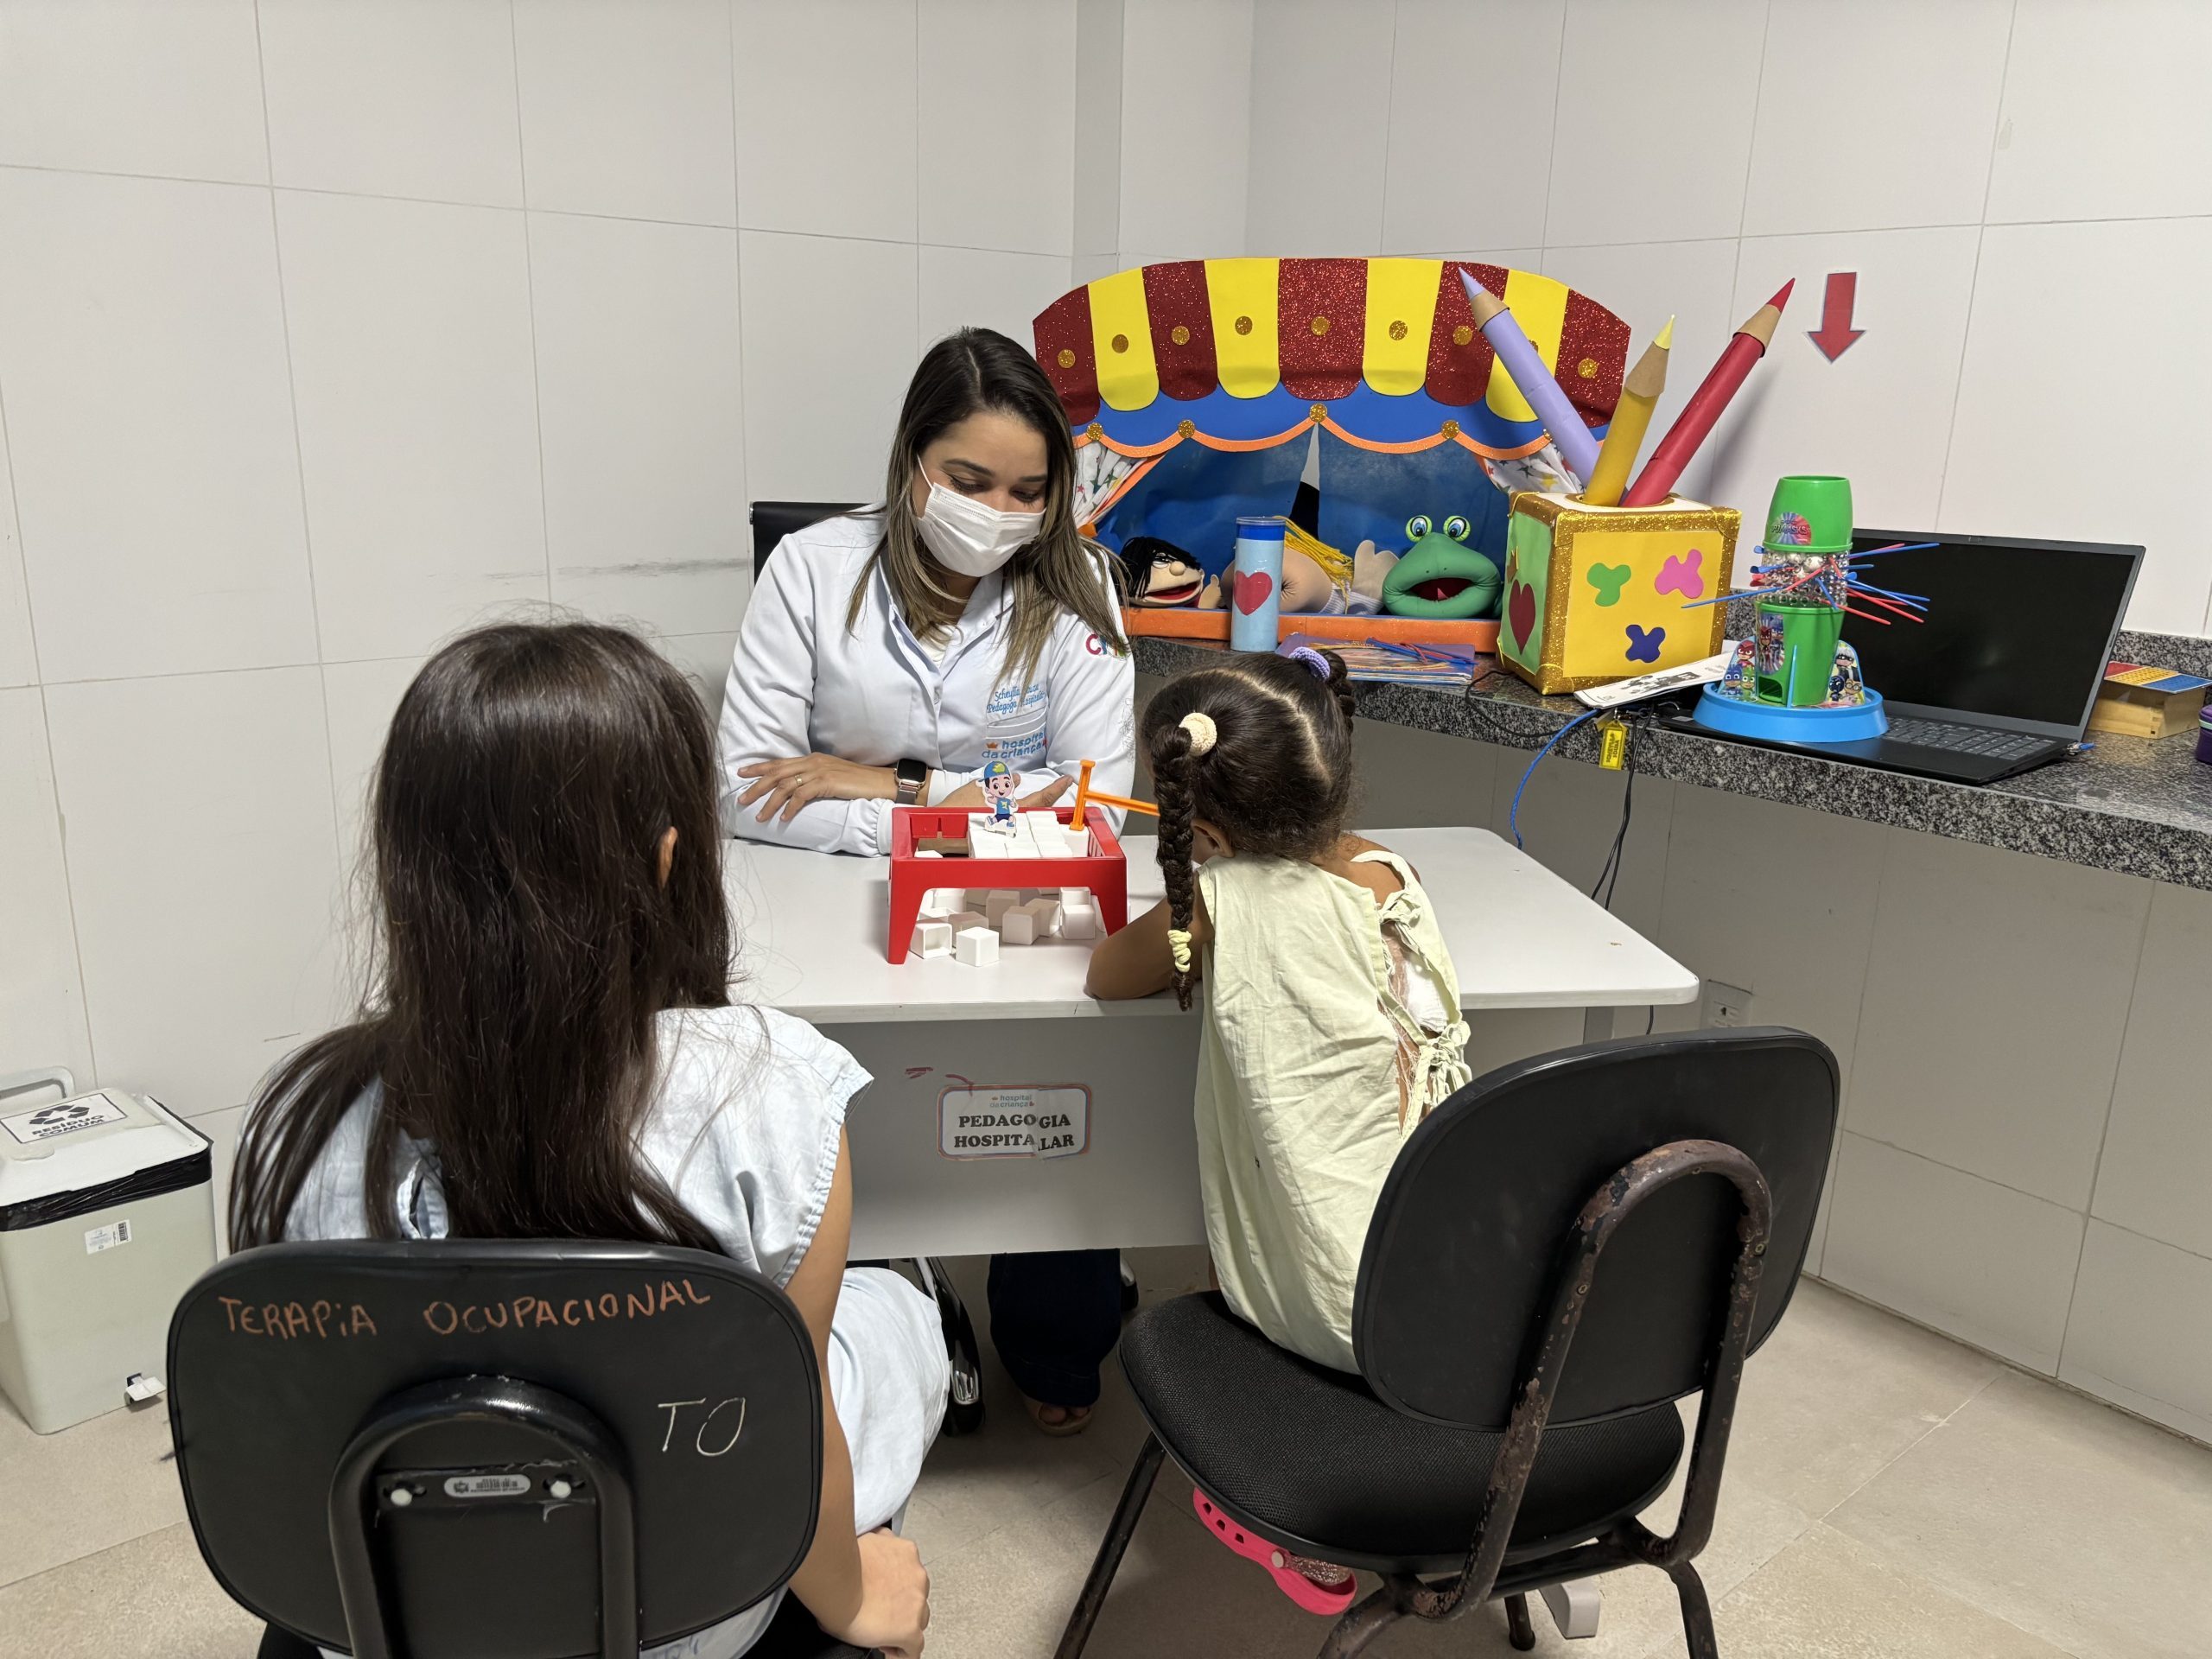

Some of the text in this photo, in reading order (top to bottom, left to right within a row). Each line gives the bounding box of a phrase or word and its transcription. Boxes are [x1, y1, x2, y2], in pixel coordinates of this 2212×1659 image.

[1002, 730, 1046, 749] hospital
[982, 750, 998, 759] da
[39, 1119, 105, 1136] COMUM
[958, 1114, 1071, 1129] PEDAGOGIA
[953, 1134, 1075, 1152] HOSPITALAR
[423, 1279, 711, 1335] OCUPACIONAL
[658, 1396, 746, 1457] TO
